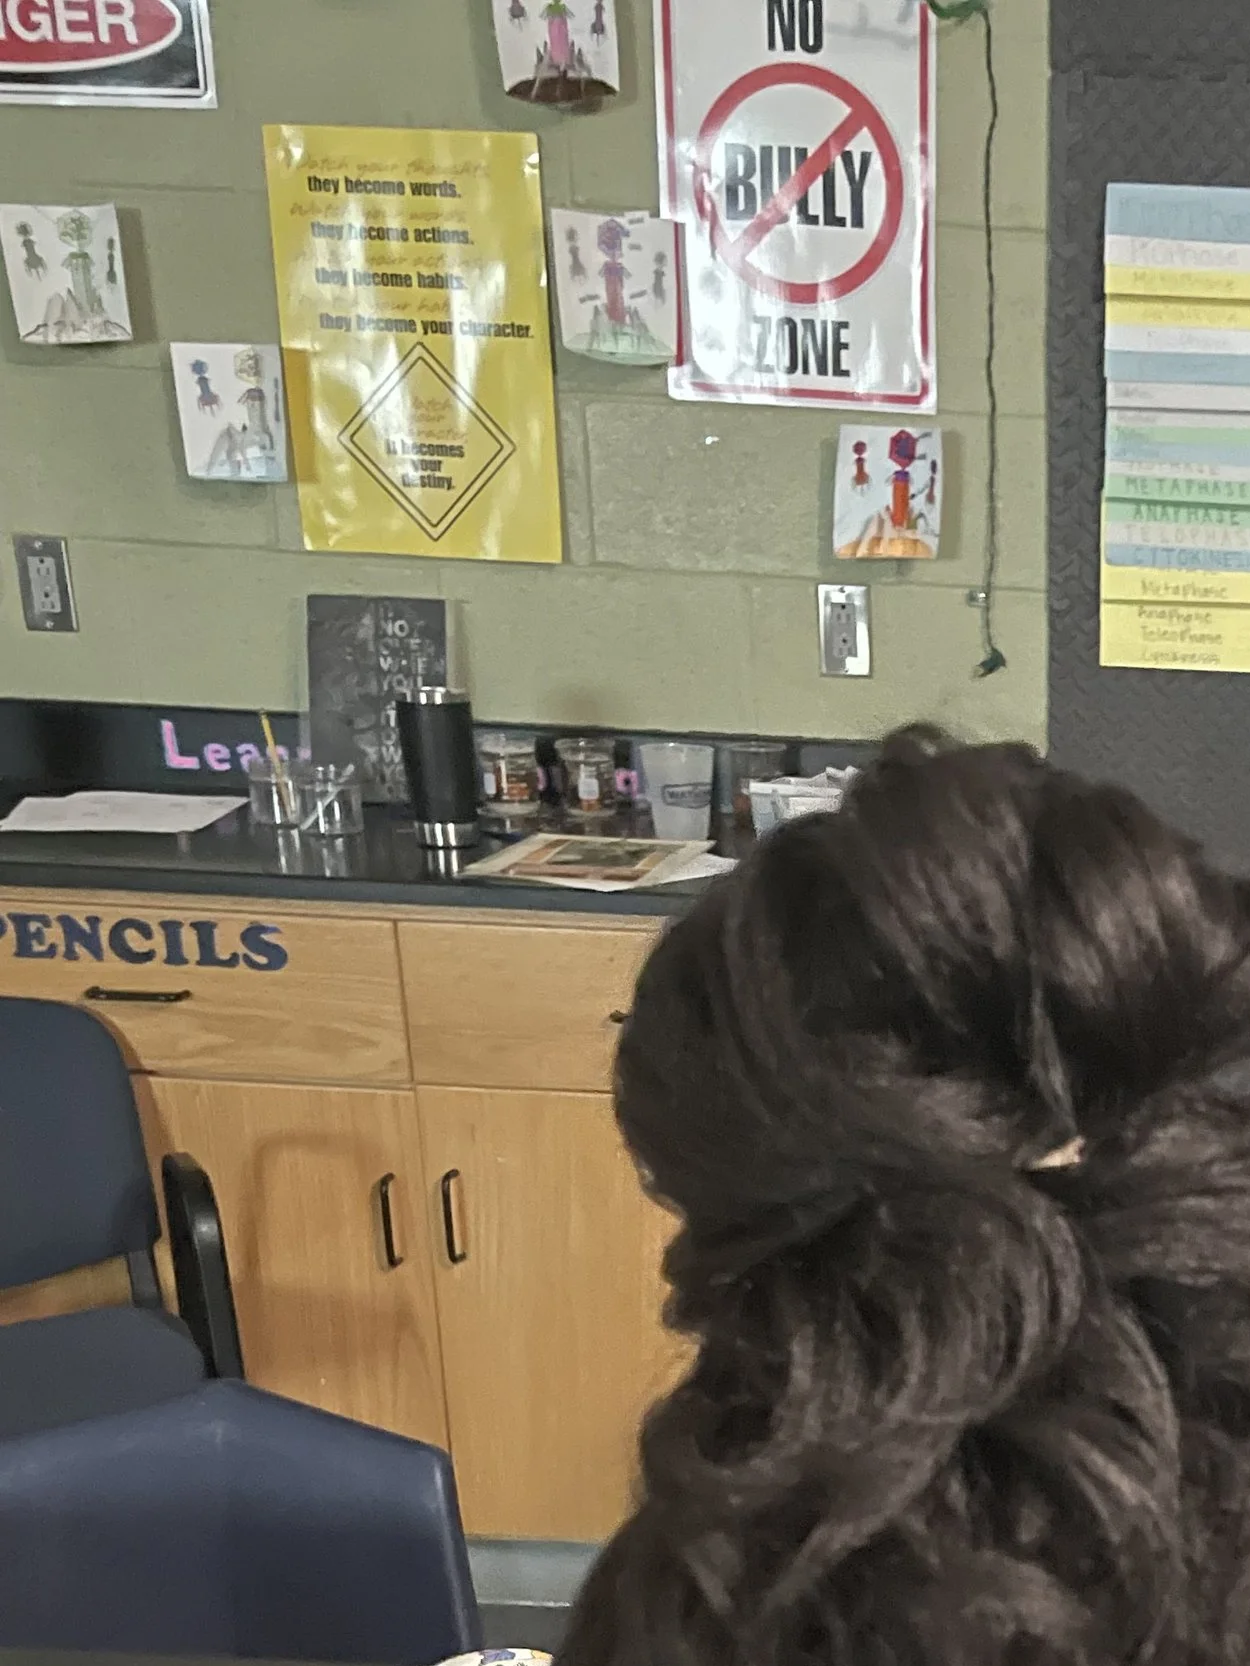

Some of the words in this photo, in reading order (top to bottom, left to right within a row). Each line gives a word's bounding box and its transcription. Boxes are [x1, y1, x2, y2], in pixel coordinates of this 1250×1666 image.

[0, 0, 138, 44] GER
[766, 0, 825, 53] NO
[307, 175, 340, 194] they
[345, 175, 405, 196] become
[410, 180, 462, 199] words.
[724, 142, 872, 229] BULLY
[311, 221, 344, 241] they
[350, 222, 409, 243] become
[413, 226, 474, 246] actions.
[315, 268, 348, 287] they
[353, 268, 412, 288] become
[417, 271, 468, 290] habits.
[319, 313, 352, 333] they
[356, 314, 417, 333] become
[421, 318, 454, 336] your
[459, 318, 534, 339] character.
[752, 314, 852, 378] ZONE
[0, 912, 288, 971] ENCILS
